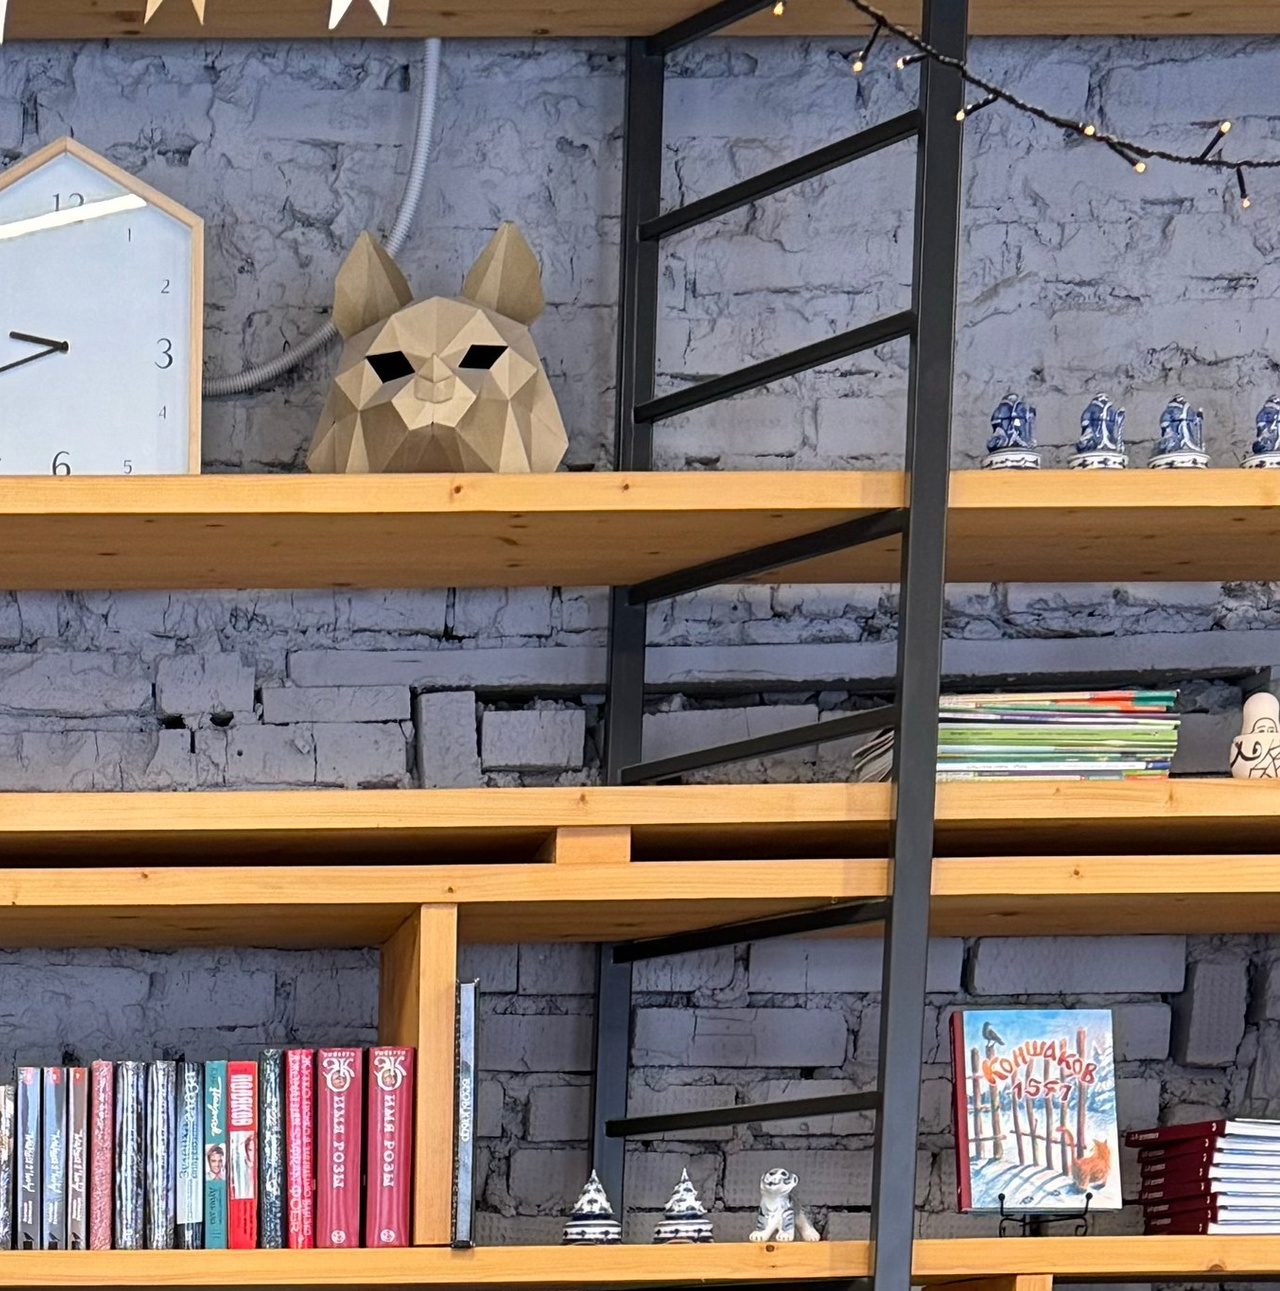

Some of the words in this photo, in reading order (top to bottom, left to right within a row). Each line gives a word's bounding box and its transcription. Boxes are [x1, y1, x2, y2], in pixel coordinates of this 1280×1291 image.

[126, 228, 133, 242] 1
[161, 279, 170, 294] 2
[154, 338, 173, 369] 3
[158, 406, 167, 419] 4
[52, 451, 72, 475] 6
[123, 460, 132, 474] 5
[333, 1095, 345, 1134] ИМЯ
[384, 1095, 396, 1134] ИМЯ
[332, 1141, 345, 1188] РОЗЫ
[383, 1141, 396, 1188] РОЗЫ
